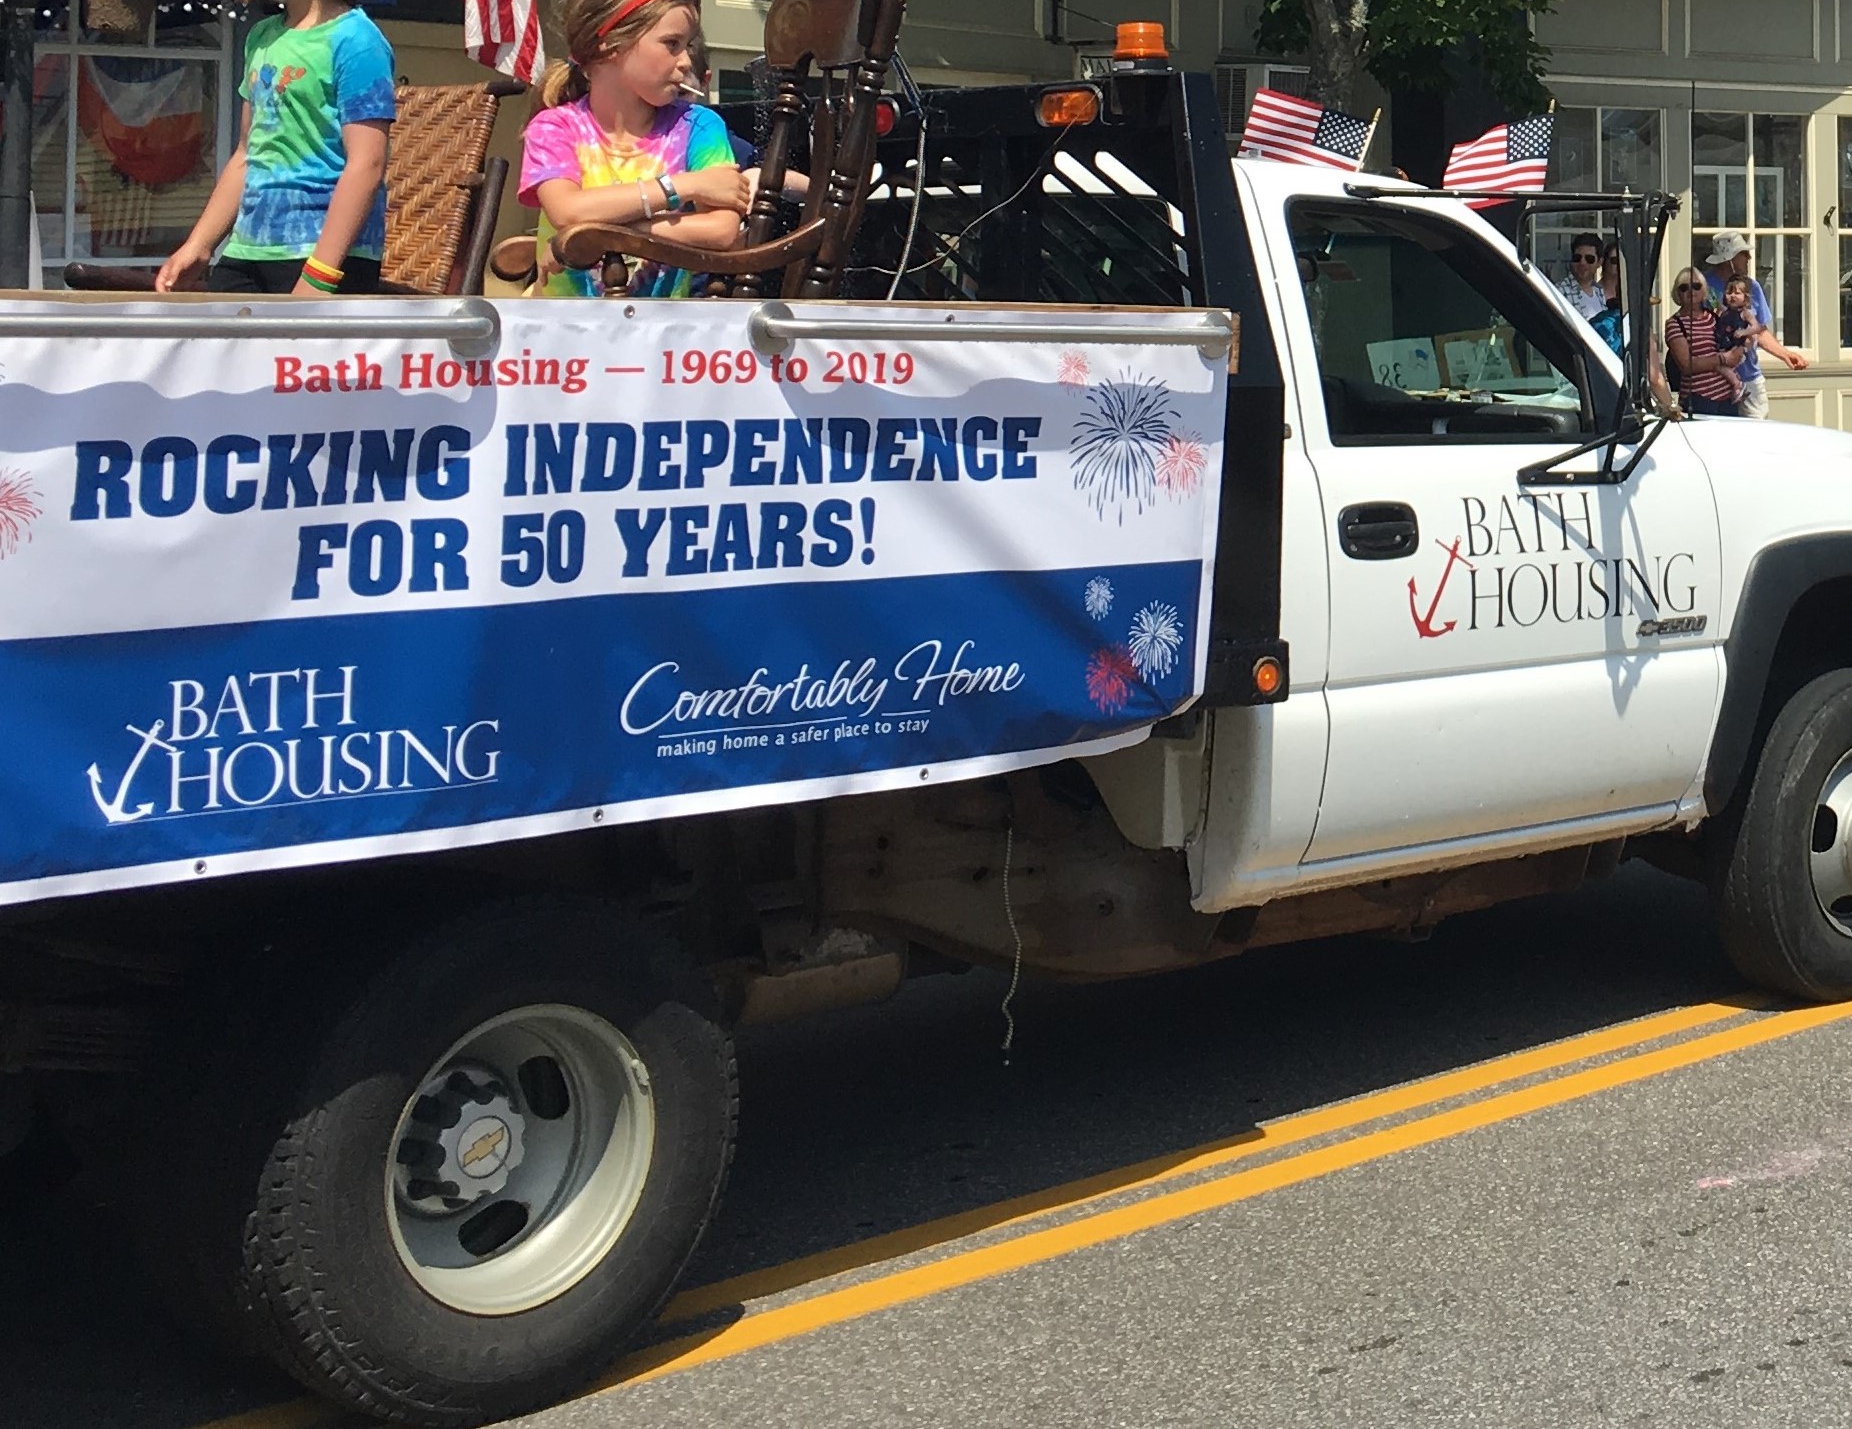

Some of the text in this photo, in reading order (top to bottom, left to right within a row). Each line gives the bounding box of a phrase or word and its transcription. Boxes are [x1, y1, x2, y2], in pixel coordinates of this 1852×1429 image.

[273, 353, 384, 394] Bath
[399, 348, 590, 394] Housing
[661, 350, 757, 385] 1969
[770, 353, 808, 383] to
[822, 351, 915, 385] 2019
[70, 415, 1042, 521] ROCKING INDEPENDENCE
[291, 496, 877, 601] FOR 50 YEARS!
[1461, 491, 1596, 557] BATH
[1467, 552, 1697, 631] HOUSING
[167, 665, 358, 742] BATH
[619, 639, 1026, 736] Comfortably Home
[165, 719, 501, 814] HOUSING
[657, 718, 930, 758] making home a safer place to stay
